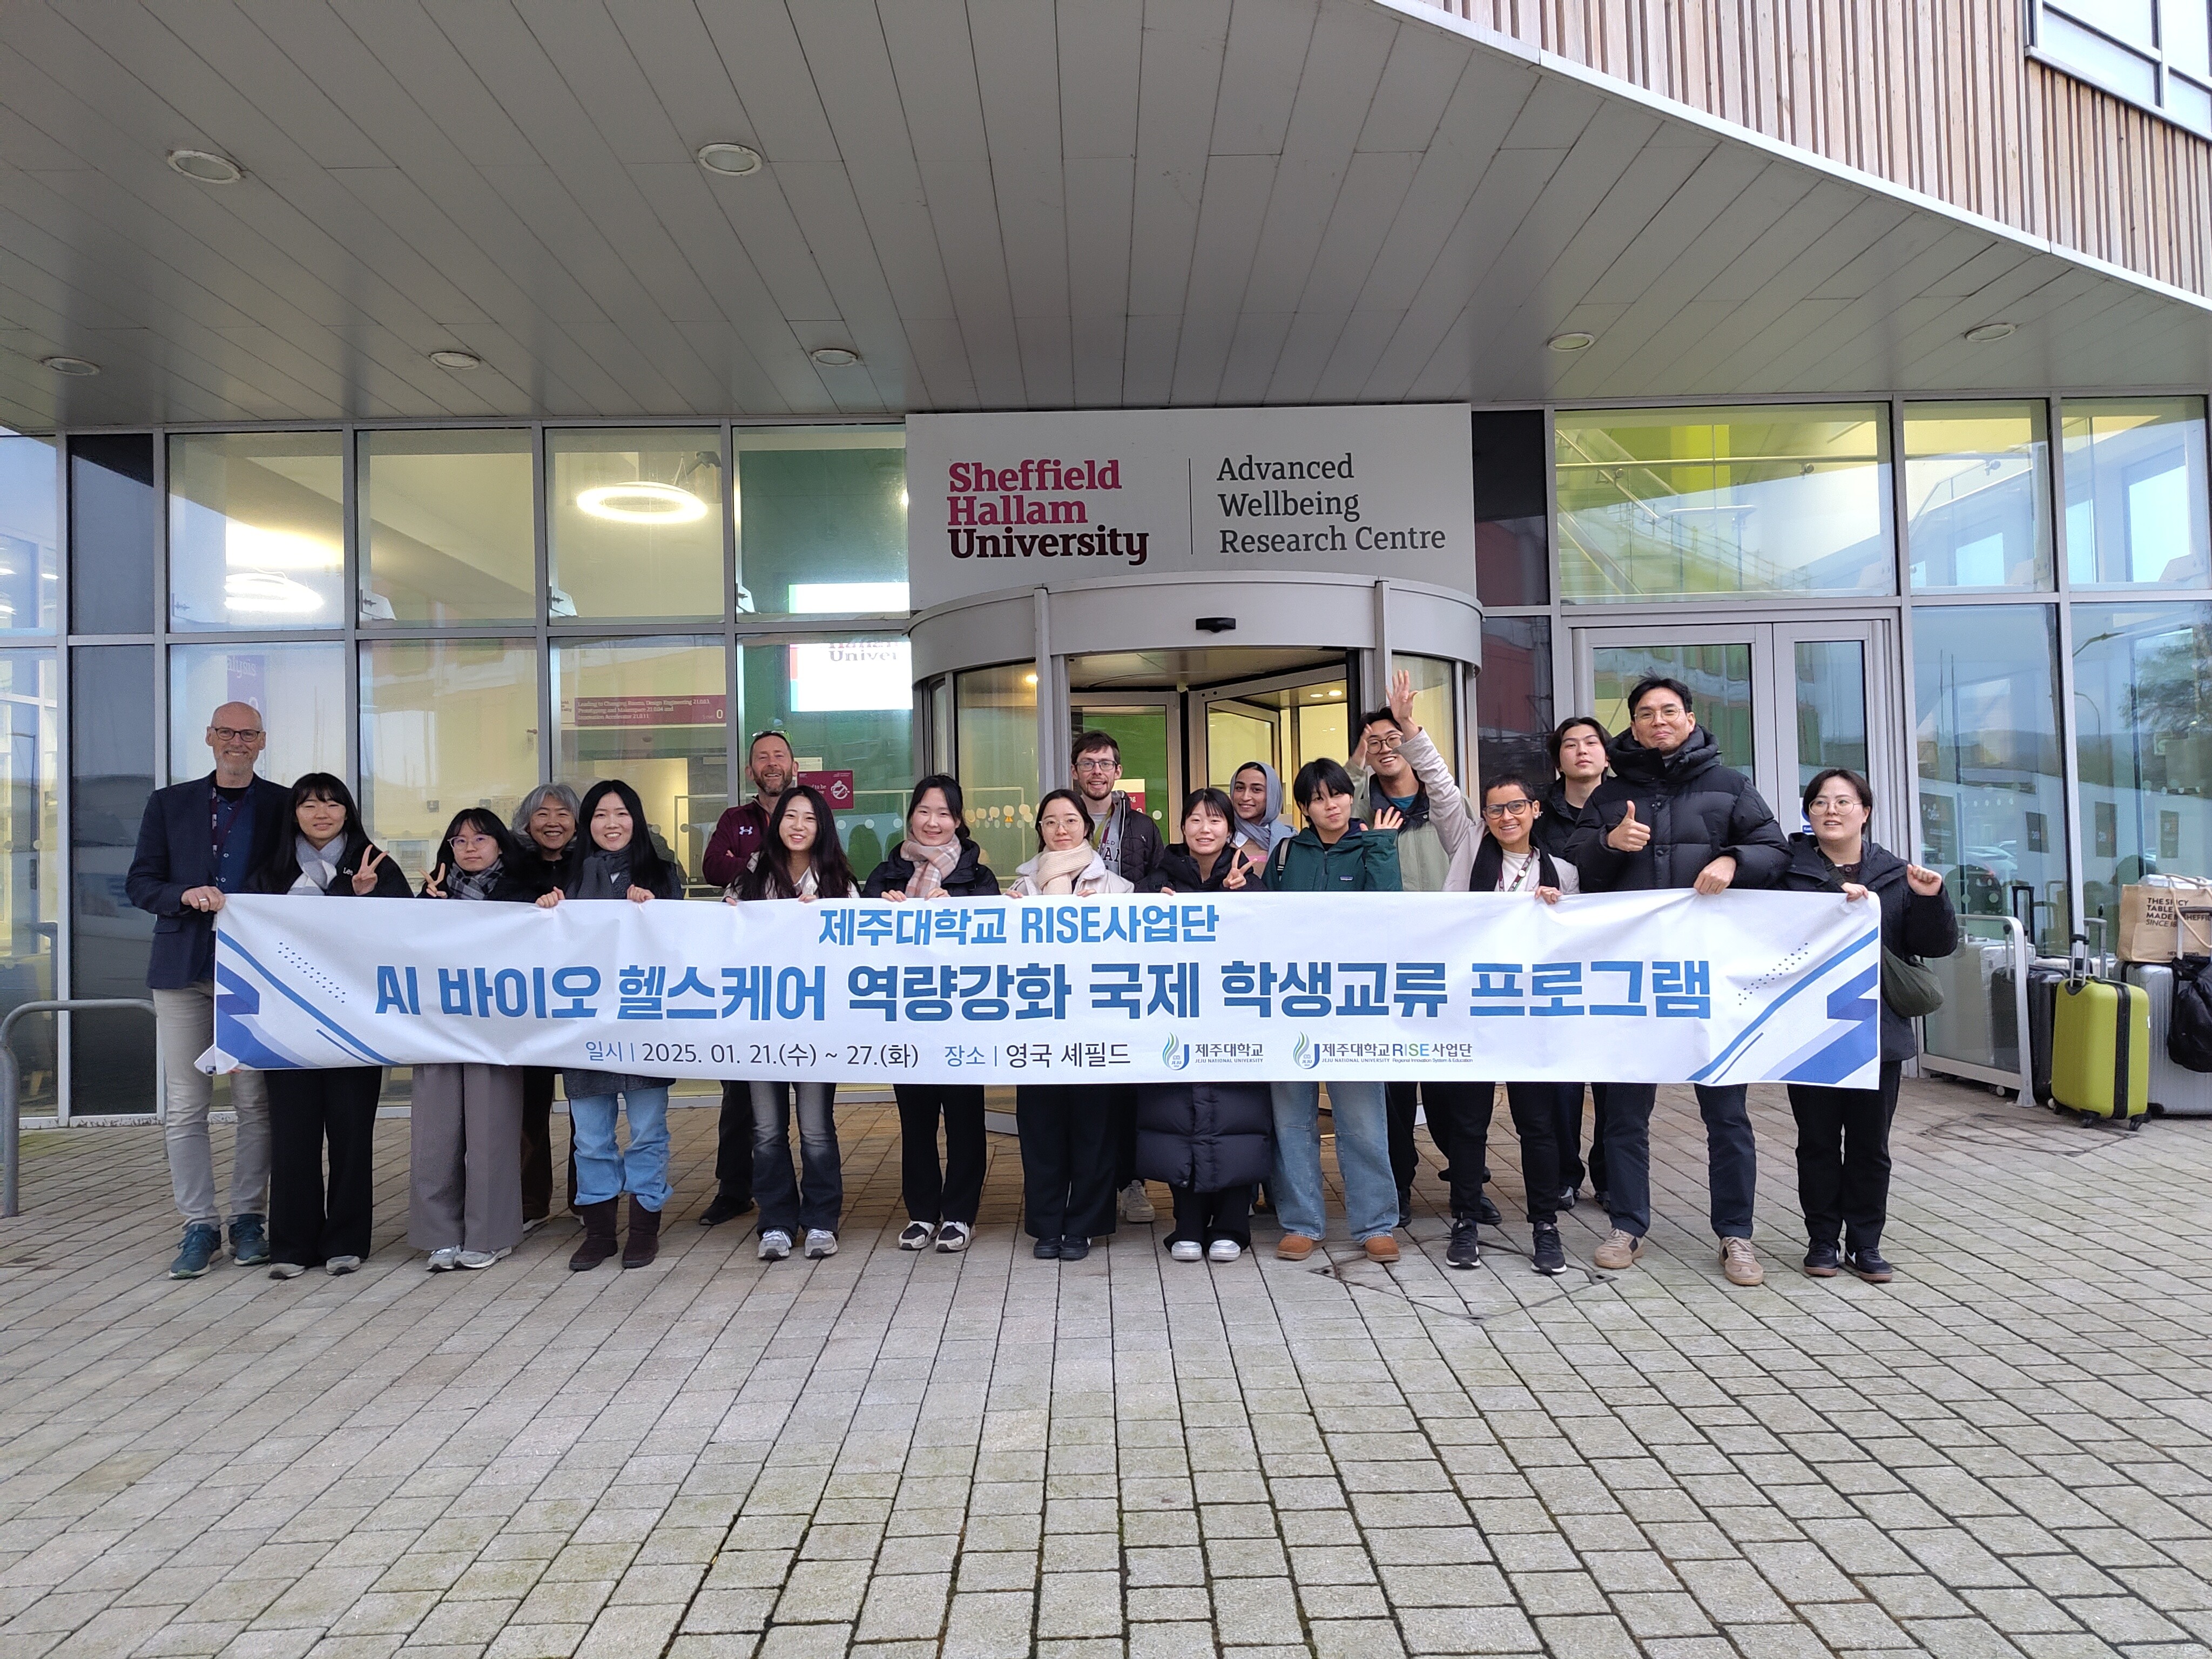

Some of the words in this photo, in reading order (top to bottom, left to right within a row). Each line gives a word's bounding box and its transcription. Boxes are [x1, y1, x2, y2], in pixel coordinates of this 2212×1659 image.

[948, 459, 1123, 493] Sheffield
[1216, 453, 1354, 481] Advanced
[946, 495, 1088, 526] Hallam
[1217, 490, 1360, 523] Wellbeing
[947, 524, 1149, 567] University
[1219, 525, 1347, 554] Research
[1355, 526, 1446, 550] Centre
[716, 709, 723, 719] 0
[343, 867, 353, 875] Lee
[2146, 905, 2173, 913] TABLE
[2147, 897, 2163, 905] THE
[819, 907, 1007, 946] 제주대학교
[1021, 905, 1219, 944] RISE사업단
[2146, 919, 2169, 927] SINCE
[375, 966, 421, 1015] AI
[437, 966, 601, 1020] 바이오
[617, 964, 826, 1021] 헬스케어
[848, 963, 1072, 1022] 역량강화
[1089, 962, 1199, 1020] 국제
[1221, 960, 1448, 1019] 학생교류
[1469, 960, 1711, 1020] 프로그램
[585, 1041, 622, 1062] 일시
[642, 1043, 702, 1063] 2025.
[711, 1044, 740, 1064] 01.
[750, 1043, 817, 1067] 21.(수)
[847, 1043, 918, 1068] 27.(화)
[945, 1044, 986, 1067] 장소
[1006, 1043, 1053, 1068] 영국
[1061, 1042, 1131, 1068] 셰필드
[1195, 1043, 1264, 1057] 제주대학교
